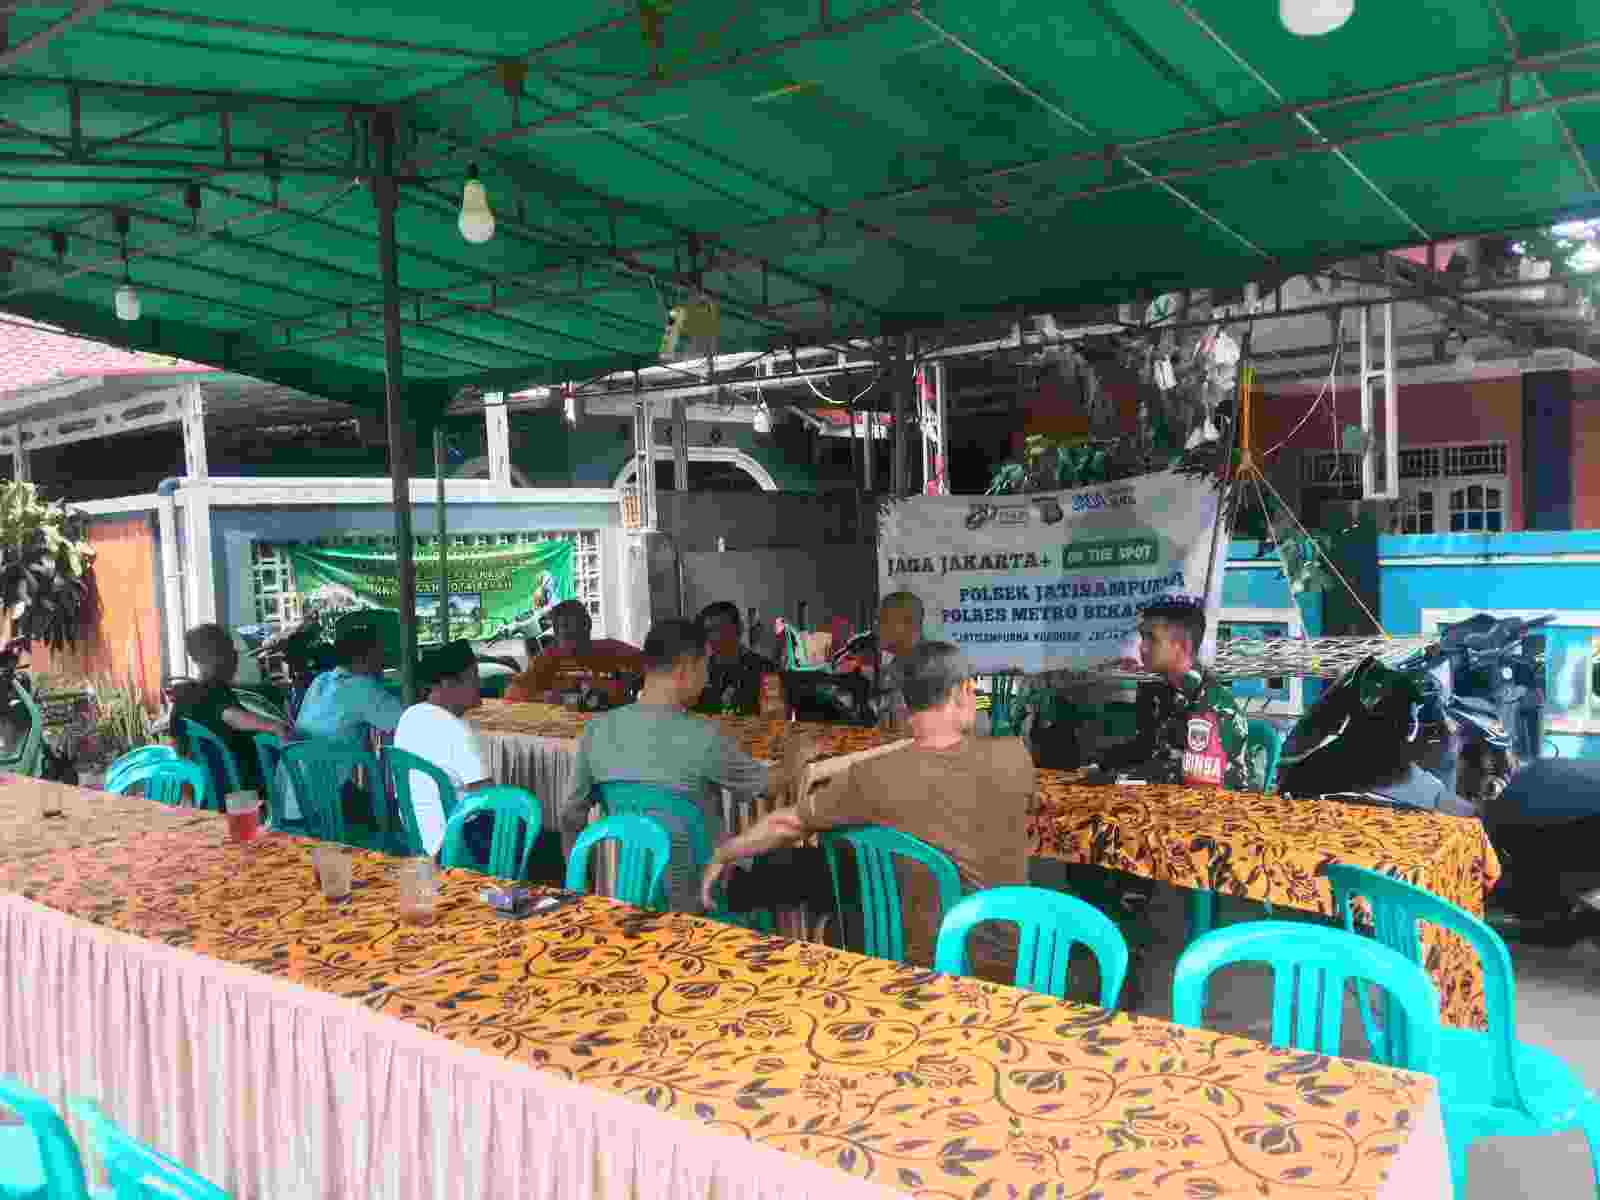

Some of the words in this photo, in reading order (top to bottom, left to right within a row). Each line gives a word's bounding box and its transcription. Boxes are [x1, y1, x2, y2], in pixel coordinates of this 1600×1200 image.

[1117, 545, 1154, 561] SPOT
[887, 555, 937, 576] JAGA
[943, 607, 1007, 624] POLRES
[1011, 604, 1078, 623] METRO
